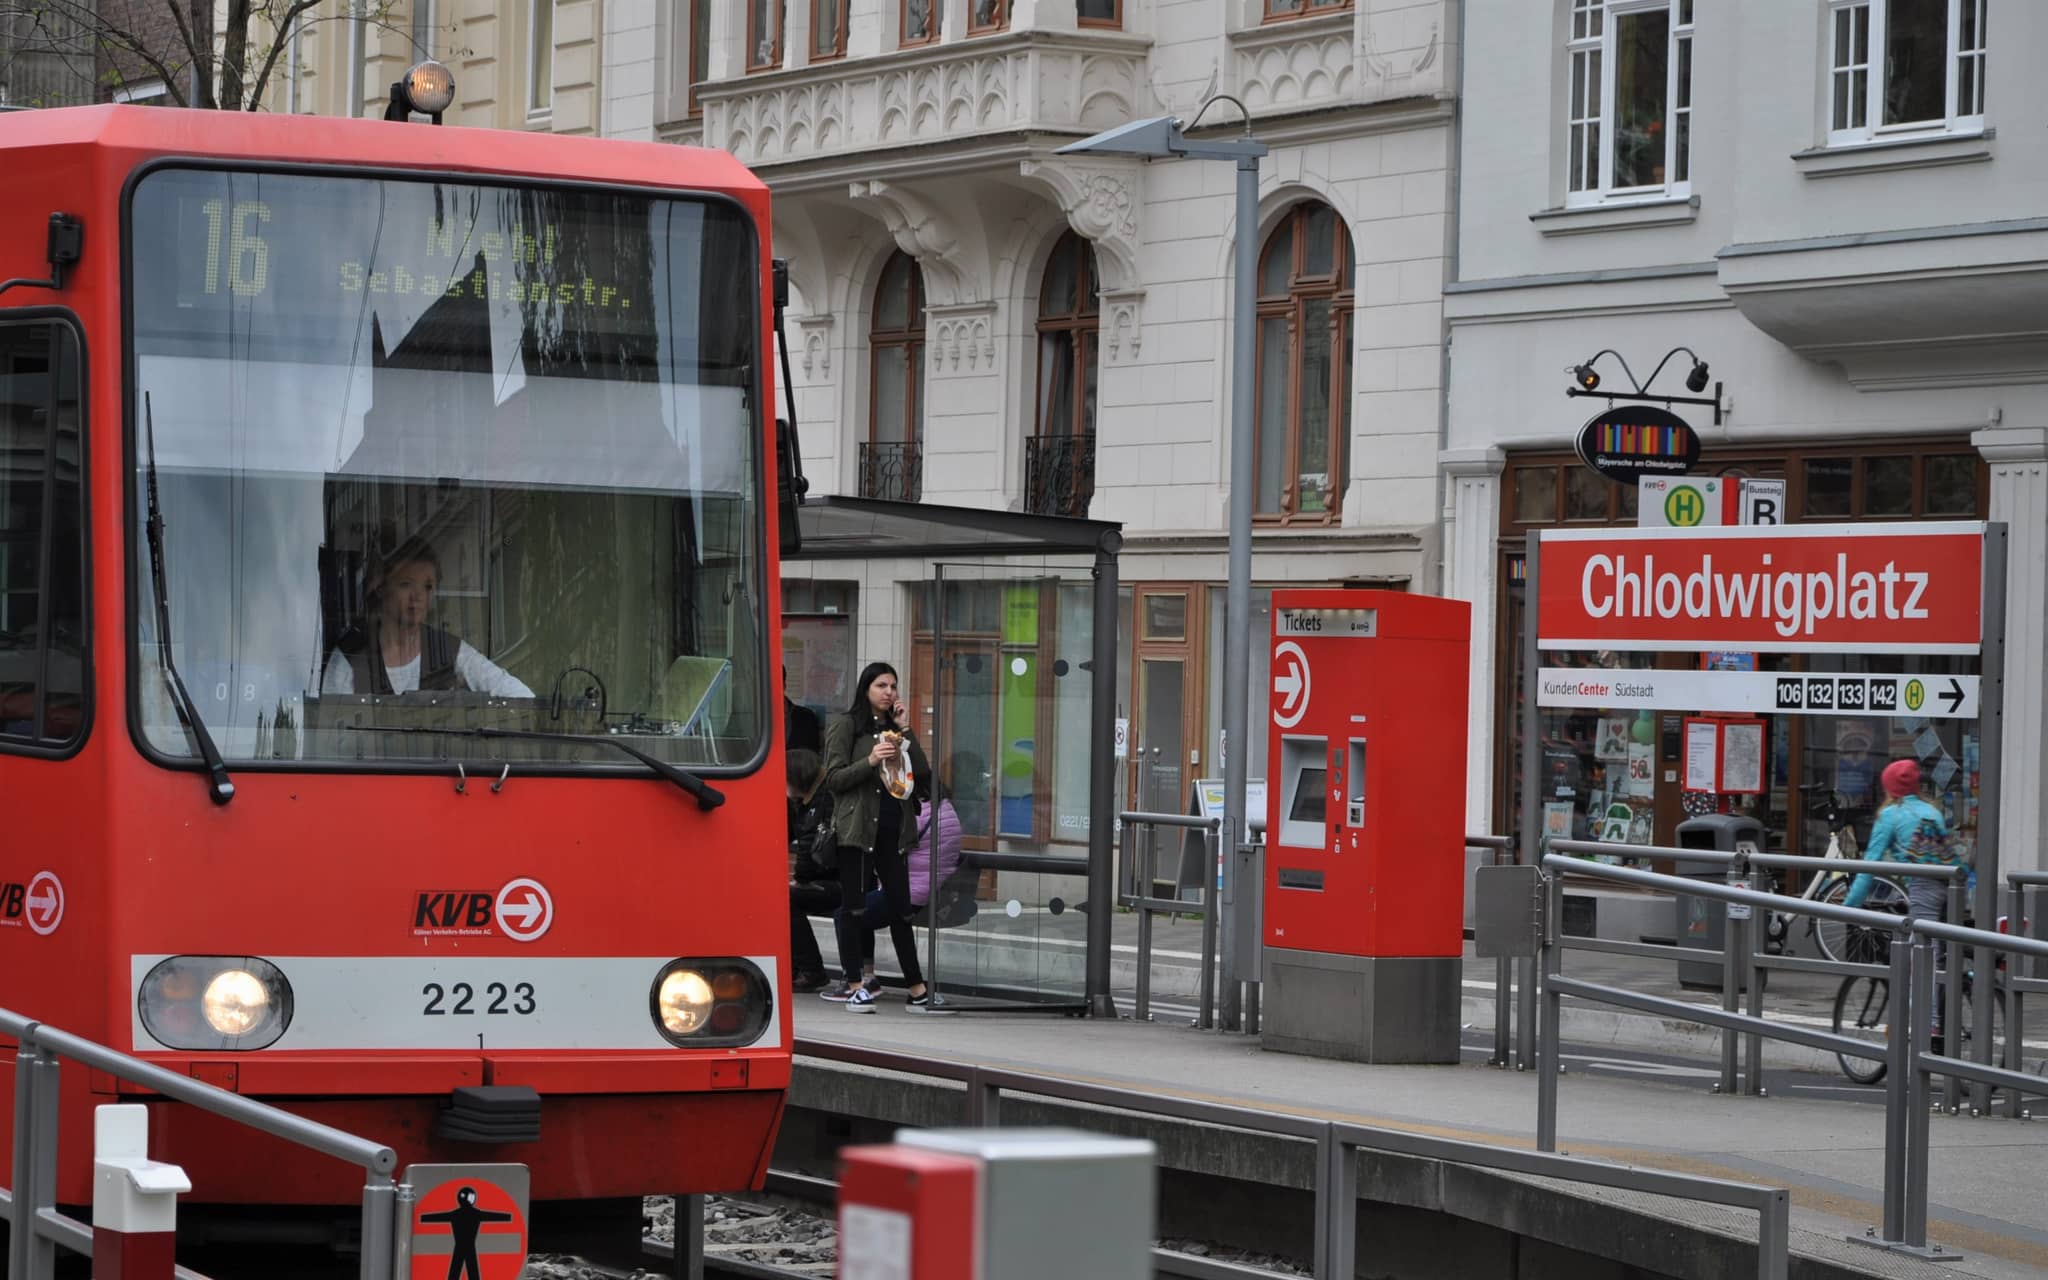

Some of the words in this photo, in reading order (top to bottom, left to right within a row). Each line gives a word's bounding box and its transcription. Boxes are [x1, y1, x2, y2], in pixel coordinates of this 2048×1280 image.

[200, 198, 272, 298] 16
[339, 260, 633, 309] Sebastianstr.
[1581, 552, 1930, 637] Chlodwigplatz
[1284, 613, 1322, 632] Tickets
[1615, 682, 1654, 698] Südstadt
[1777, 683, 1802, 704] 106
[1808, 683, 1832, 704] 132
[1839, 684, 1864, 705] 133
[1871, 685, 1896, 706] 142
[414, 893, 493, 927] KVB
